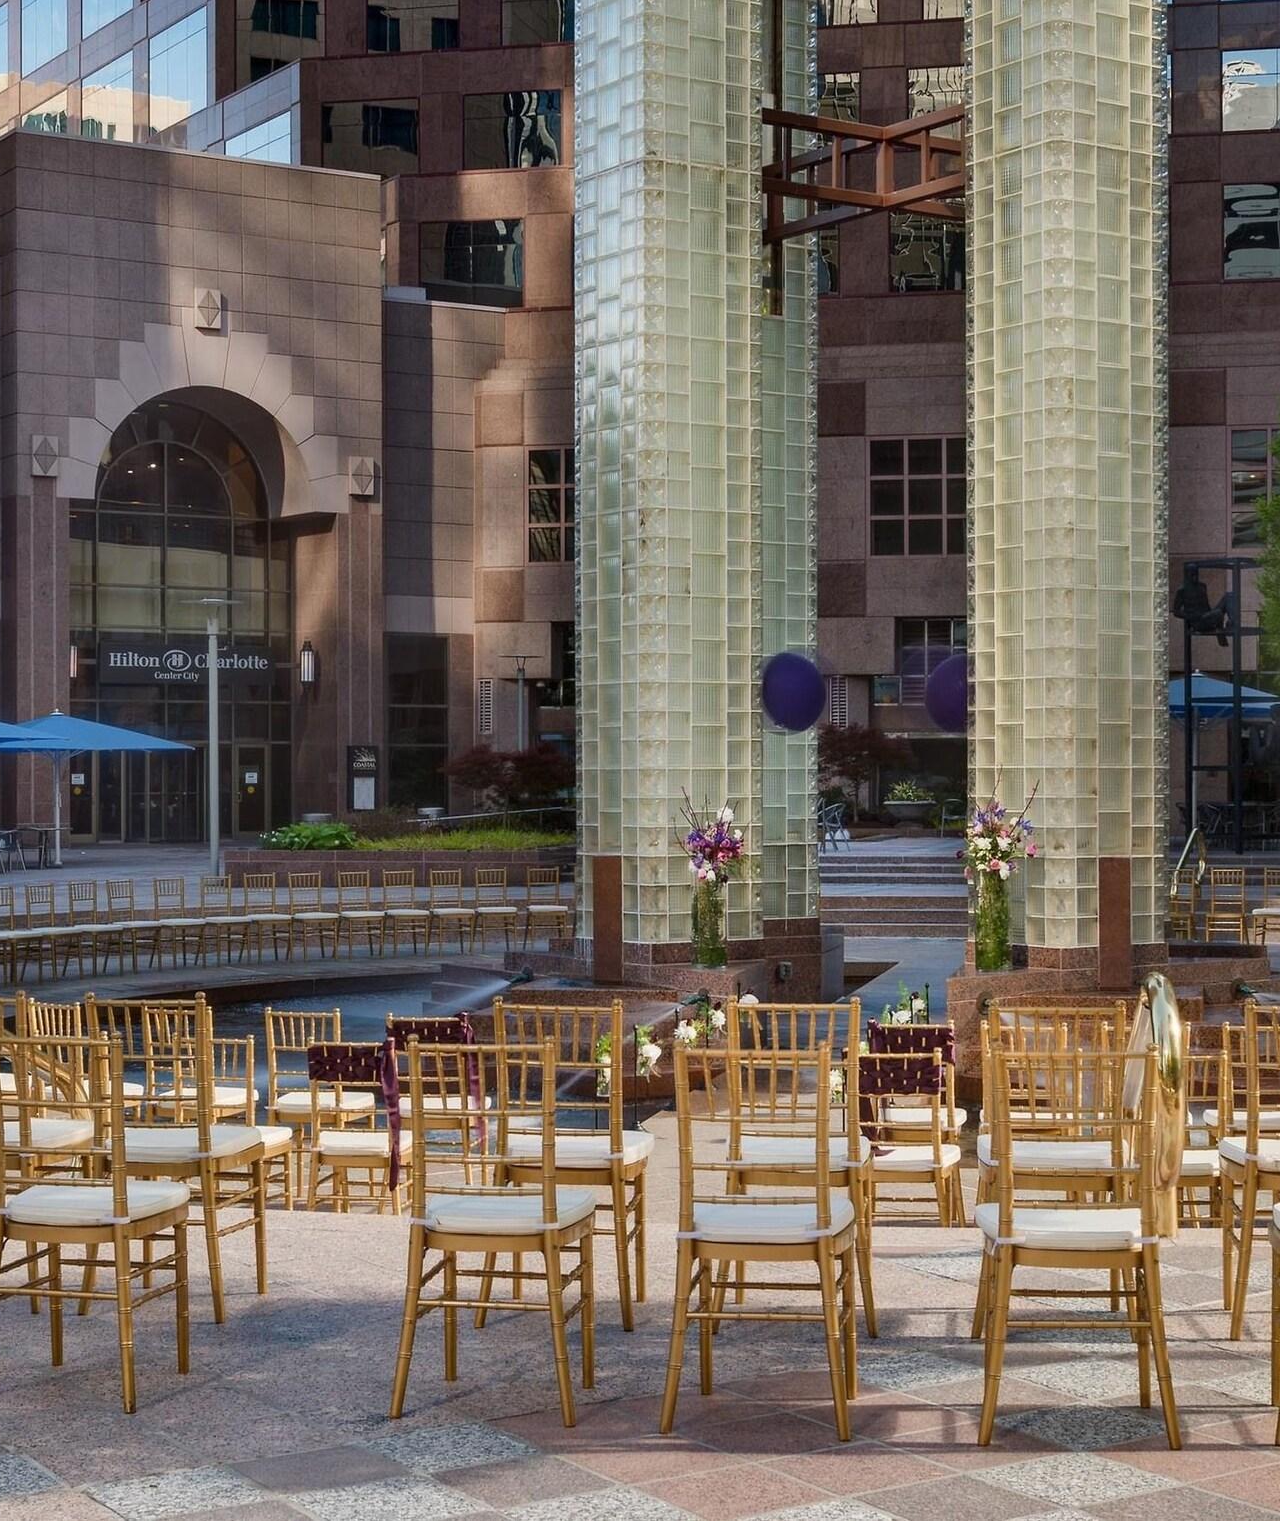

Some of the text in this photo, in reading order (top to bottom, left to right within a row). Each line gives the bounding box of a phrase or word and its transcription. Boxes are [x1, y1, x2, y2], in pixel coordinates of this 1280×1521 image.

[109, 651, 160, 668] Hilton
[154, 670, 199, 683] Center City
